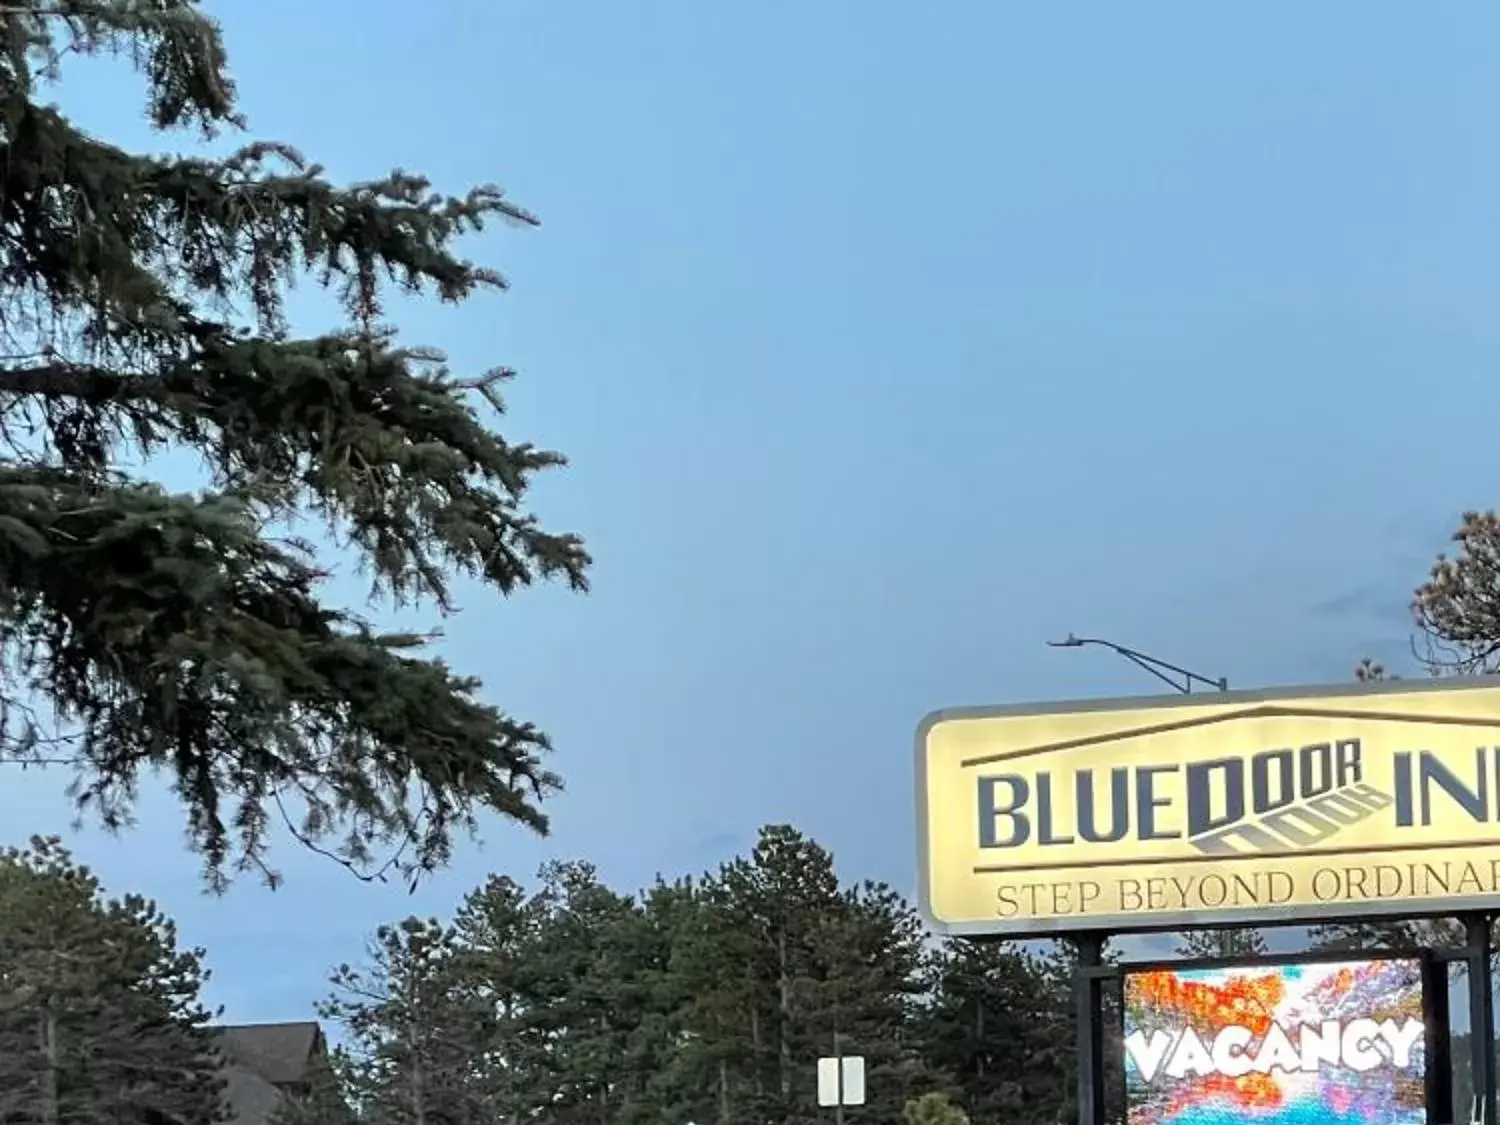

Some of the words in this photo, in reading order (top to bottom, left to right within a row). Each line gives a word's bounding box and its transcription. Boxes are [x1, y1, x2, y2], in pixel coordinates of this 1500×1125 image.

[996, 882, 1101, 917] STEP
[1119, 871, 1294, 911] BEYOND
[1124, 1017, 1426, 1083] VACANCY
